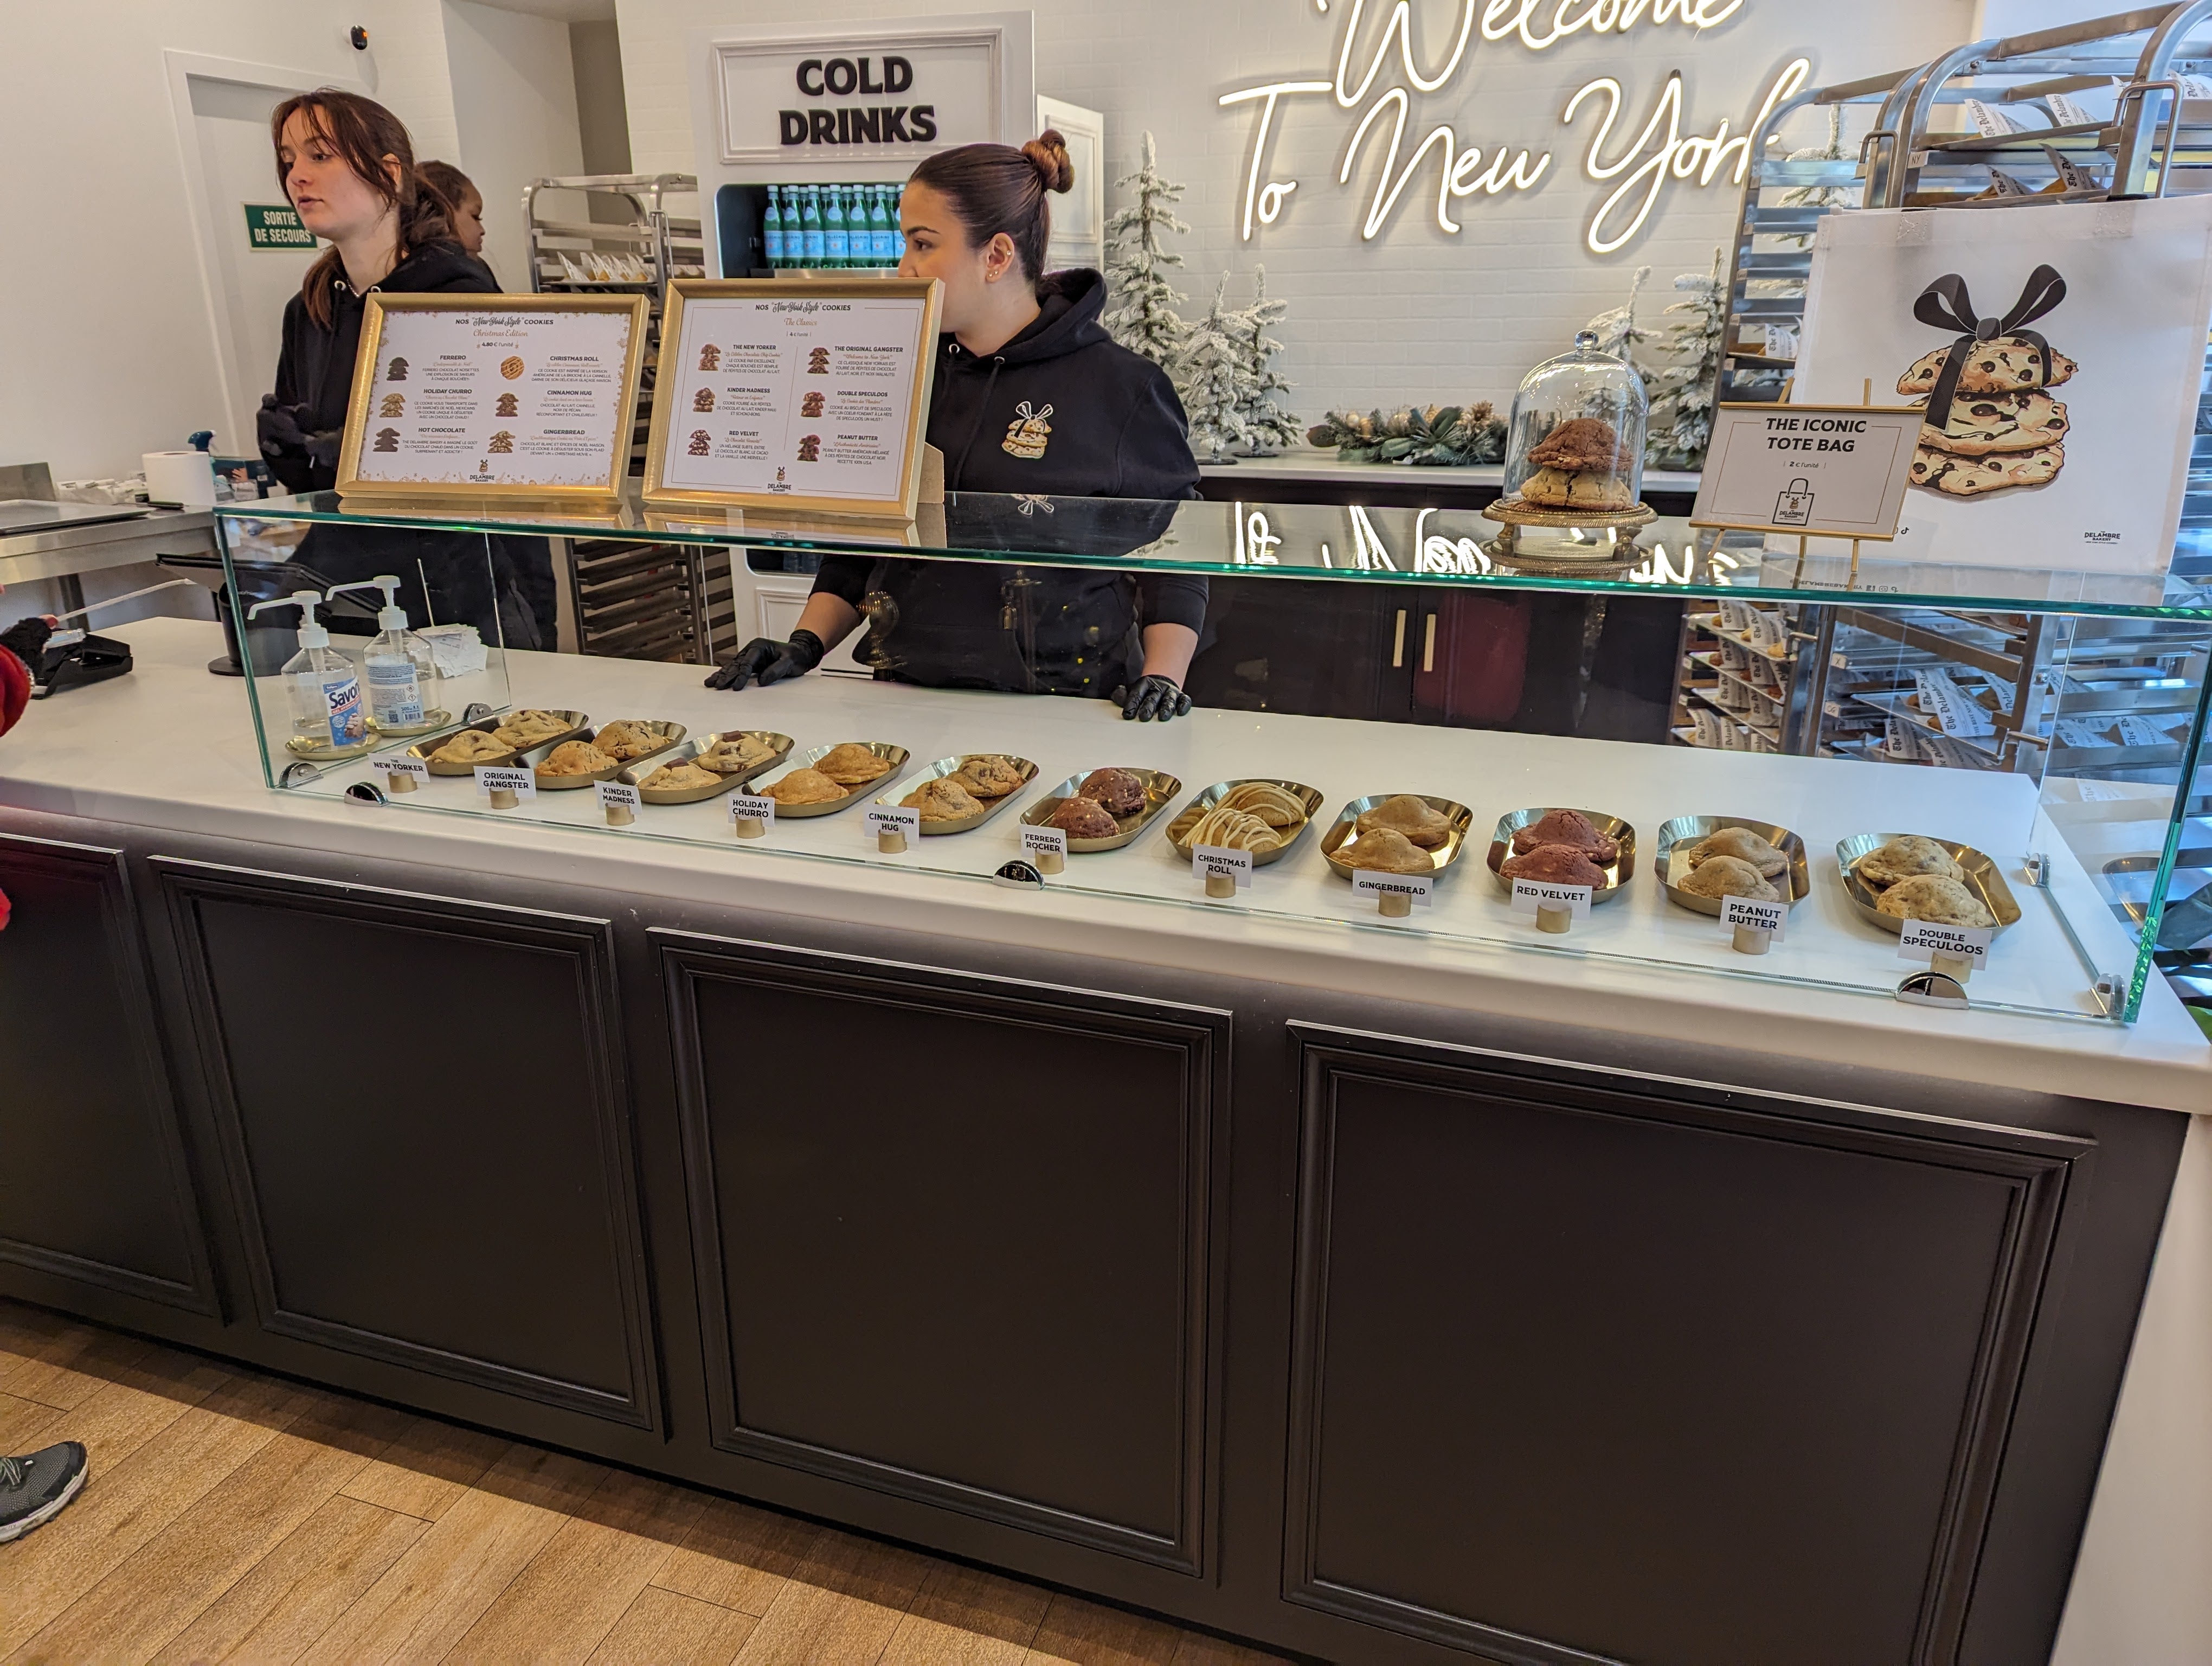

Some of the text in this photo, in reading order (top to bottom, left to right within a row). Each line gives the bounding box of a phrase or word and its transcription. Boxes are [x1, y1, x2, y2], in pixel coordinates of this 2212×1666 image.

[796, 56, 913, 96] COLD
[779, 105, 937, 145] DRINKS
[1219, 81, 1333, 241] To
[1339, 87, 1552, 240] New
[263, 211, 297, 225] SORTIE
[254, 228, 311, 242] DE SECOURS
[788, 302, 803, 312] York
[489, 317, 504, 326] York
[784, 318, 818, 326] The Classics
[473, 329, 528, 337] Christmas Edition
[1766, 418, 1867, 433] THE ICONIC
[1767, 437, 1855, 452] TOTE BAG
[329, 682, 359, 709] Savon
[373, 761, 424, 773] NEW YORKER
[484, 772, 525, 781] ORIGINAL
[483, 780, 529, 790] GANGSTER
[602, 787, 632, 797] KINDER
[602, 795, 635, 805] MADNESS
[732, 800, 768, 811] HOLIDAY
[732, 808, 769, 818] CHURRO
[869, 812, 915, 825] CINNAMON
[882, 823, 899, 832] HUG
[1025, 834, 1061, 844] FERRERO
[1026, 842, 1060, 853] ROCHER
[1198, 854, 1246, 868] CHRISTMAS
[1207, 864, 1232, 875] ROLL
[1359, 881, 1426, 896] GINGERBREAD
[1516, 885, 1585, 901] RED VELVET
[1729, 904, 1782, 919] PEANUT
[1728, 915, 1778, 931] BUTTER
[1919, 928, 1965, 943] DOUBLE
[1903, 937, 1984, 956] SPECULOOS
